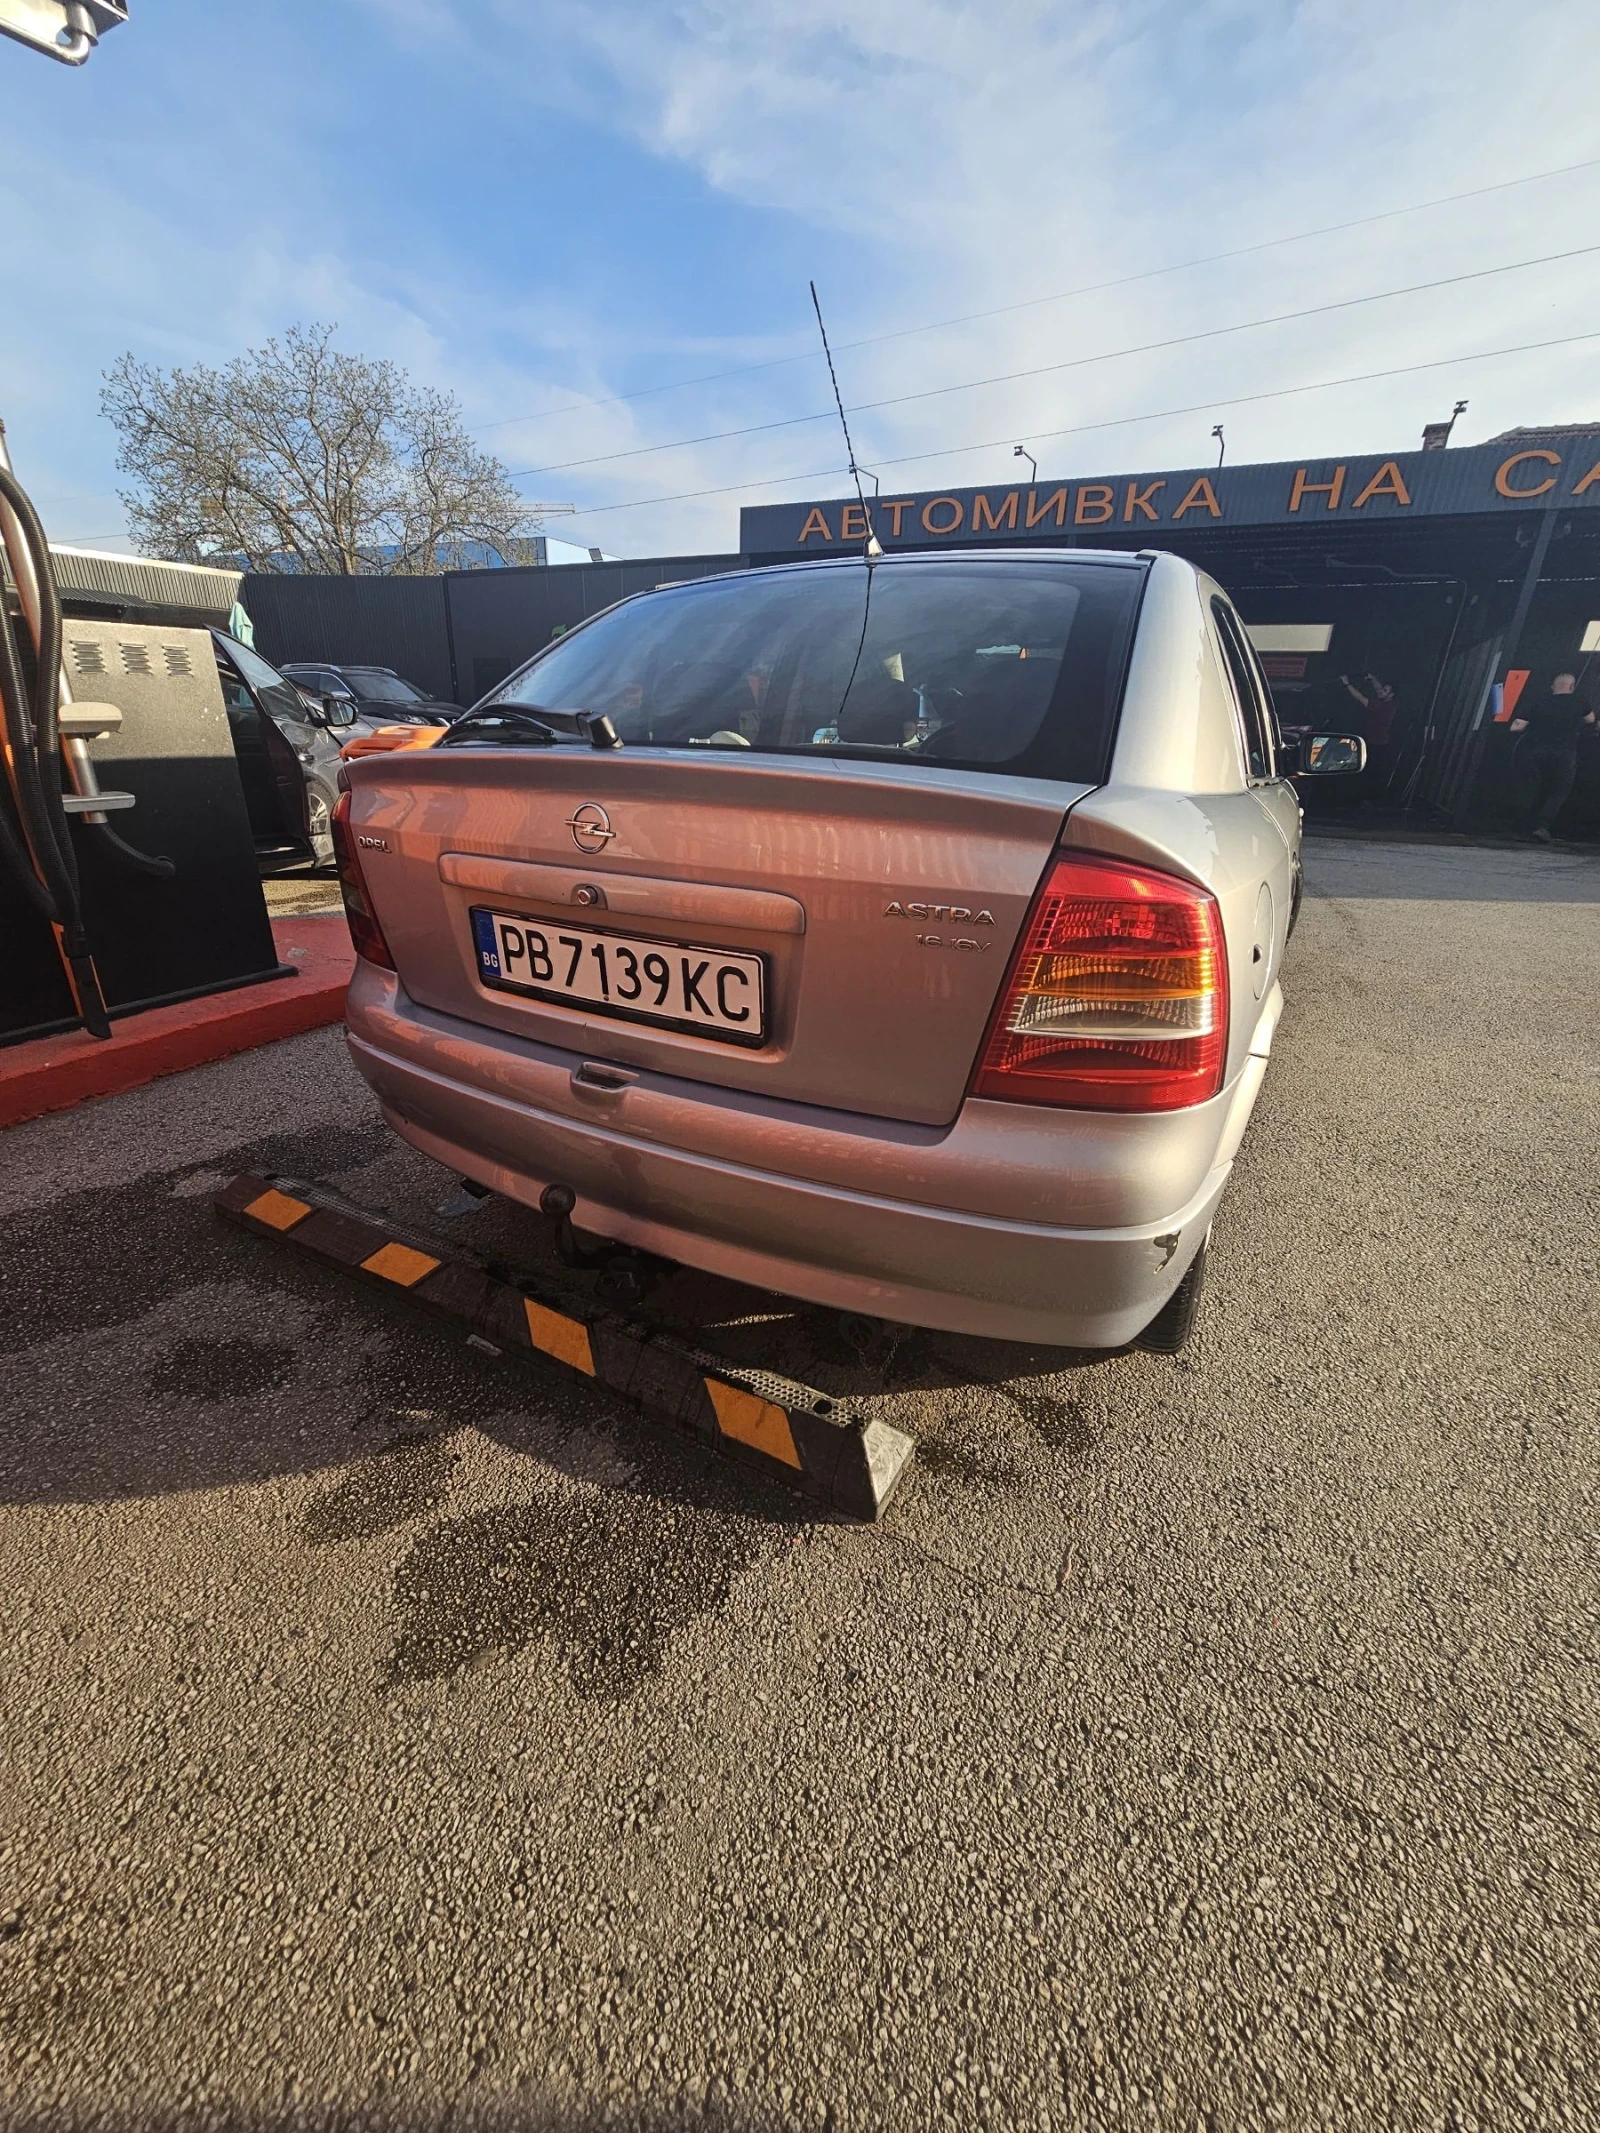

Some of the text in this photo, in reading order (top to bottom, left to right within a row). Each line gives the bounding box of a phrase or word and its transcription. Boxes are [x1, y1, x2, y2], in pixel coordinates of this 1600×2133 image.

[798, 477, 1222, 542] АВТОМИВКА
[1289, 462, 1412, 512] НА
[358, 835, 392, 854] OPEL
[883, 901, 997, 927] ASTRA
[482, 951, 499, 968] BG
